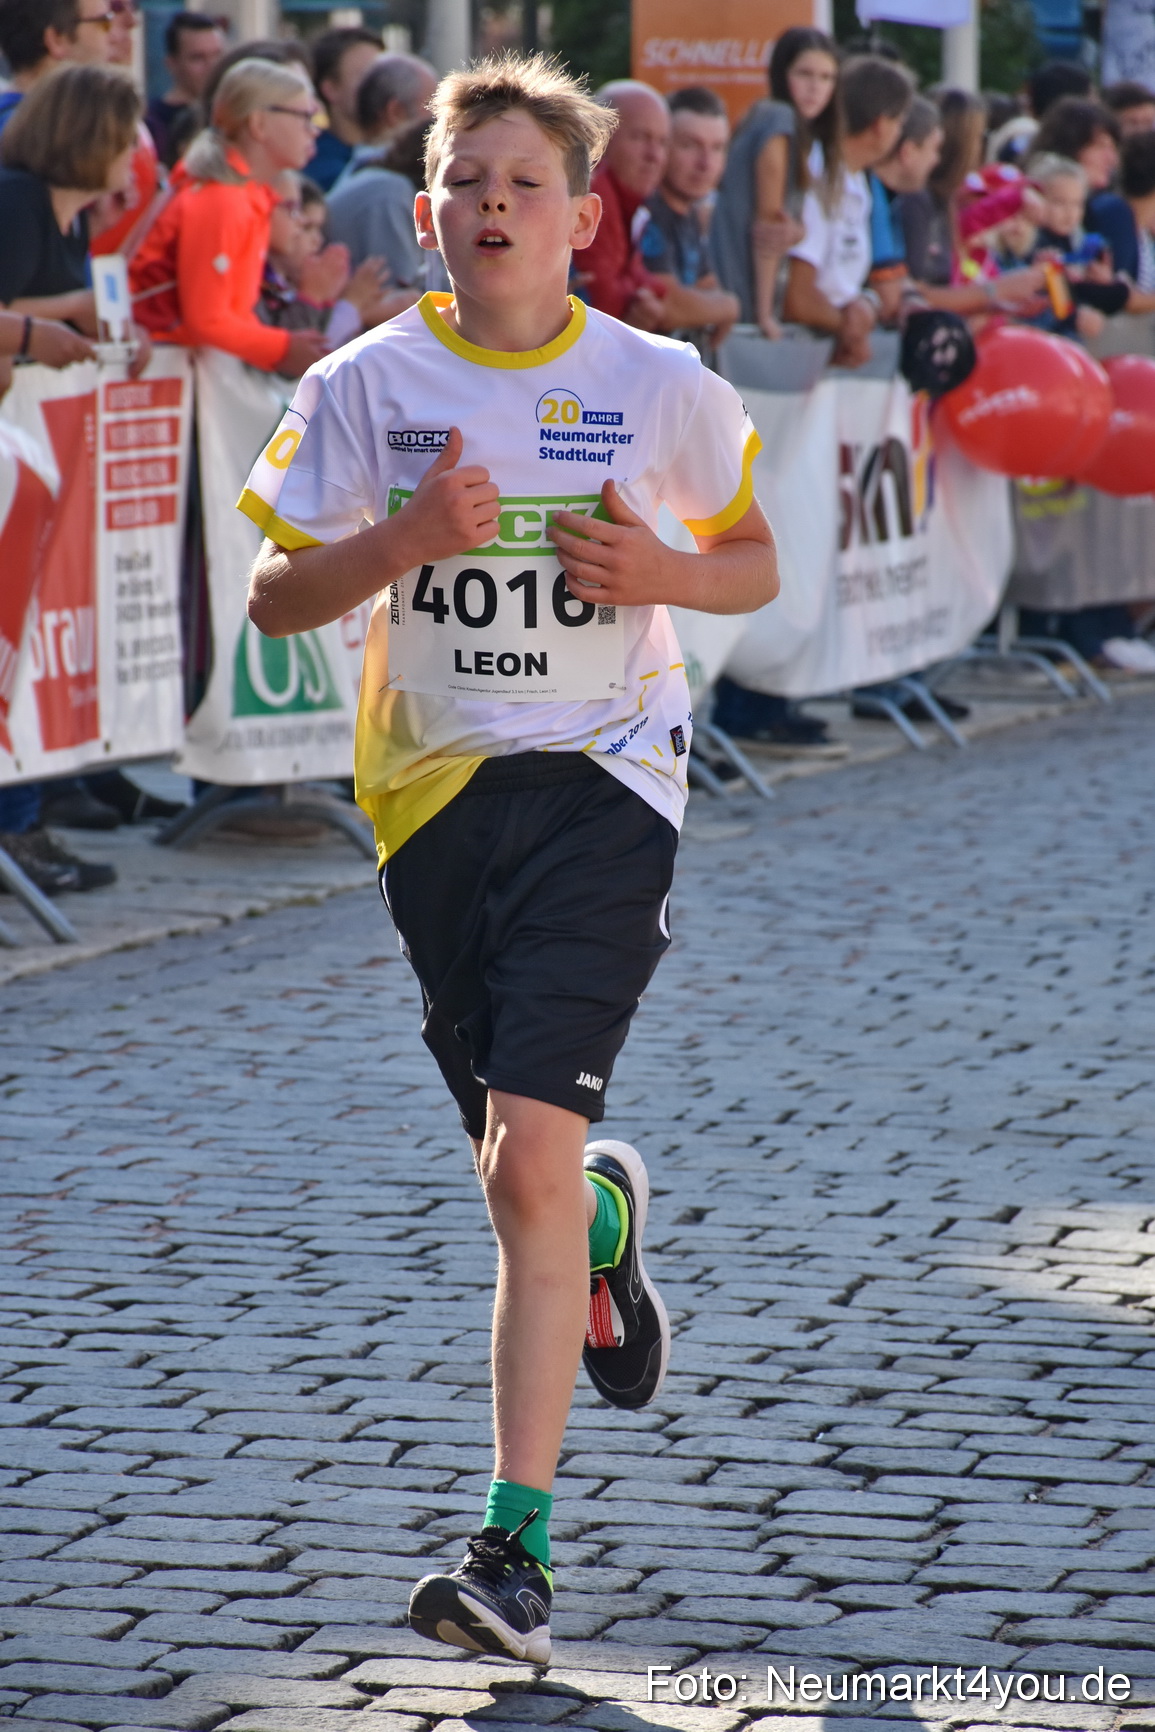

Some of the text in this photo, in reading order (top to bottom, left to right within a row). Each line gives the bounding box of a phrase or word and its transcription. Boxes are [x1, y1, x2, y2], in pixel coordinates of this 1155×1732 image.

[541, 398, 620, 425] 20 JAHRE
[387, 430, 450, 447] BOCK
[539, 428, 635, 445] Neumarkter
[538, 446, 616, 466] Stadtlauf
[411, 564, 596, 629] 4016
[454, 648, 548, 677] LEON
[628, 716, 649, 740] 2019
[575, 1071, 604, 1092] JAKO
